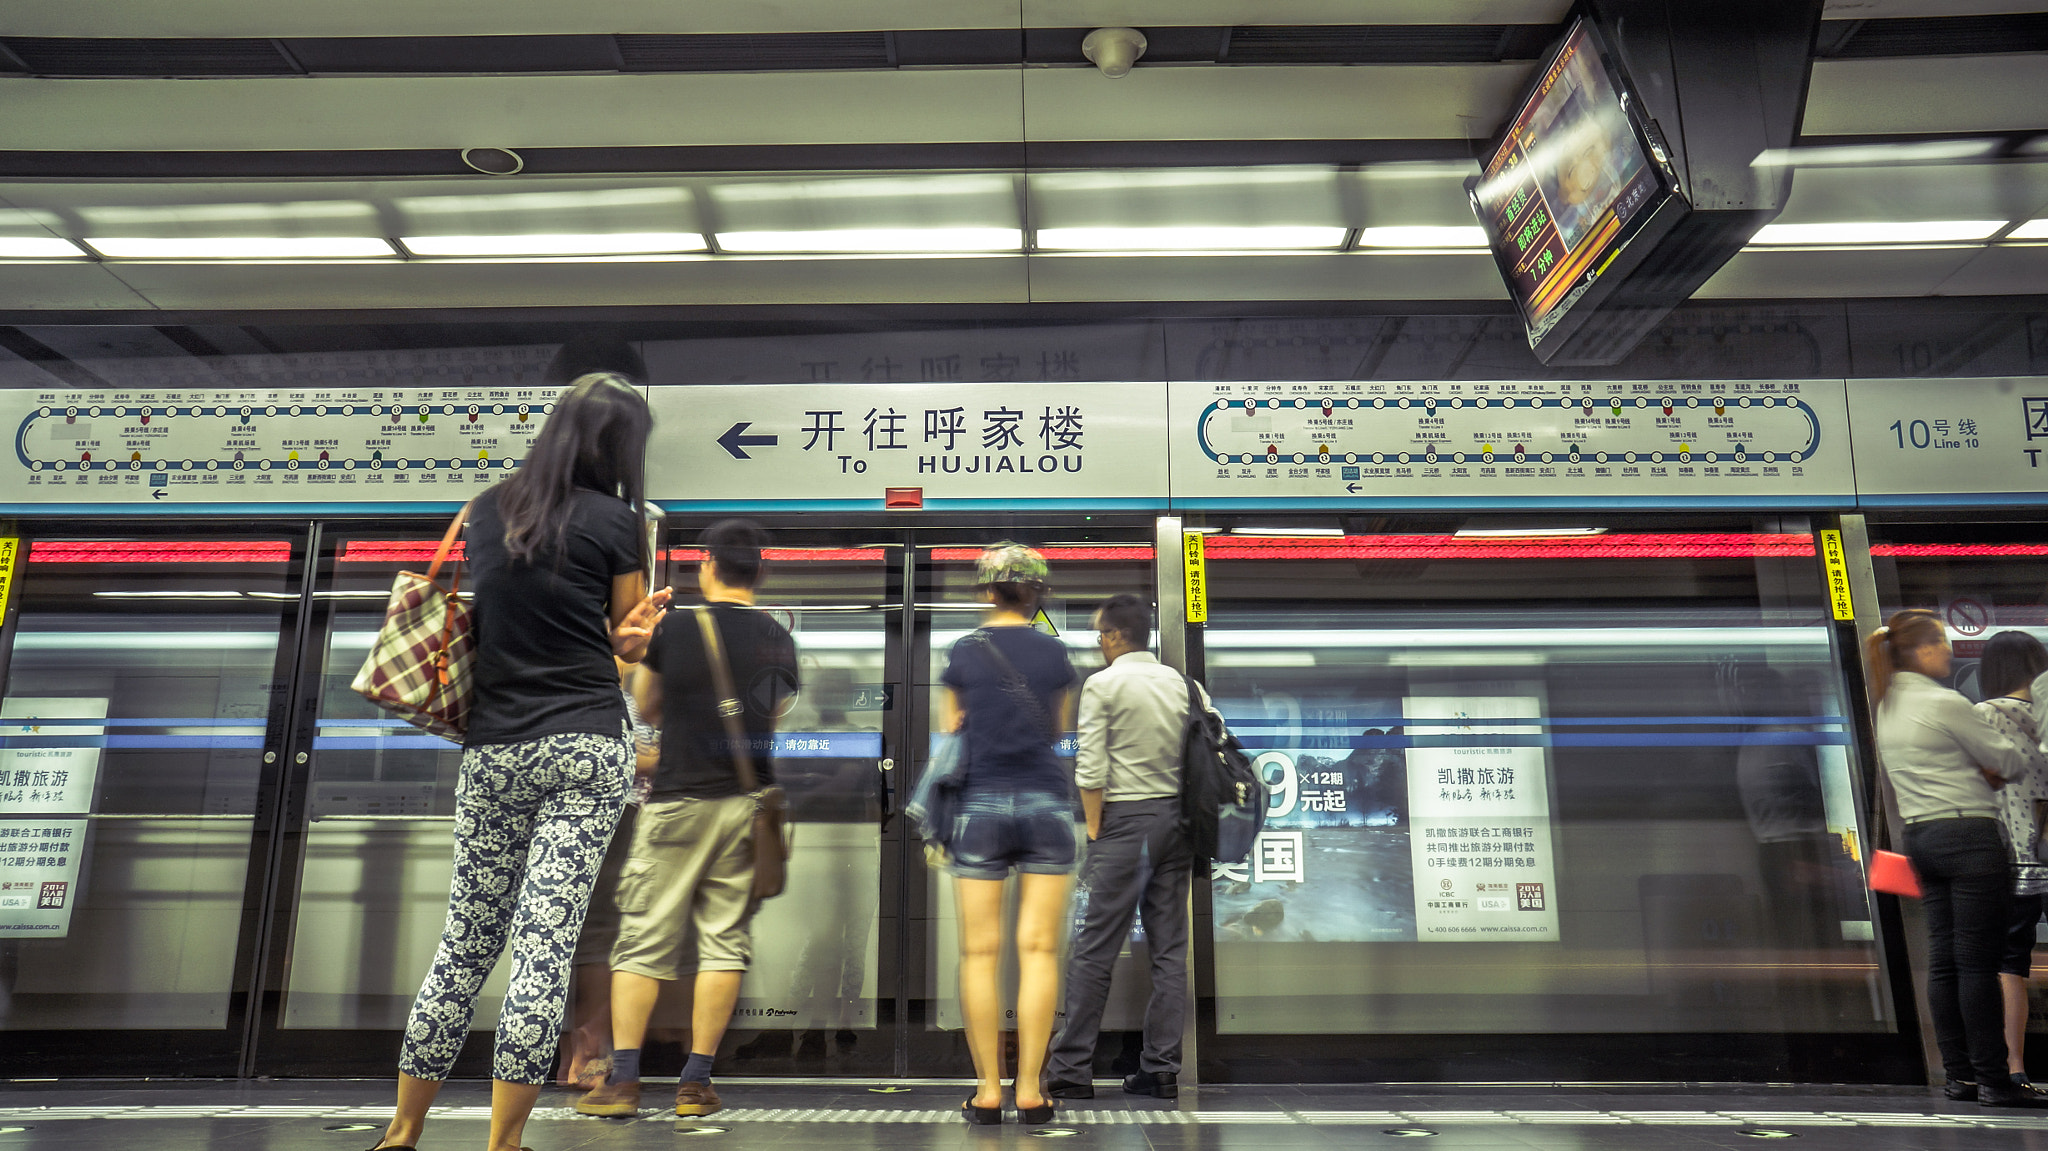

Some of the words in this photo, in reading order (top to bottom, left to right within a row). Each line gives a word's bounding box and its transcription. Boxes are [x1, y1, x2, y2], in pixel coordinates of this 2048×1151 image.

[1505, 187, 1527, 223] 首经贸
[1517, 209, 1547, 252] 即将进站
[1530, 268, 1537, 281] 7
[1537, 249, 1554, 275] 分钟
[801, 406, 1084, 452] 开往呼家楼
[1933, 439, 1960, 449] Line
[1964, 438, 1979, 448] 10
[837, 455, 868, 474] To
[918, 454, 1083, 474] HUJIALOU
[1189, 570, 1202, 618] 请勿抢上抢下
[1832, 569, 1848, 618] 请勿抢上抢下
[0, 769, 69, 787] 凯撒旅游
[1437, 767, 1515, 785] 凯撒旅游
[1300, 790, 1347, 812] 元起
[1425, 827, 1534, 838] 凯撒旅游联合工商银行
[1426, 842, 1535, 853] 共同推出旅游分期付款
[0, 857, 67, 867] 12期分期免息
[1427, 857, 1536, 868] 0手续费12期分期免息
[1480, 925, 1548, 933] www.caissa.com.cn
